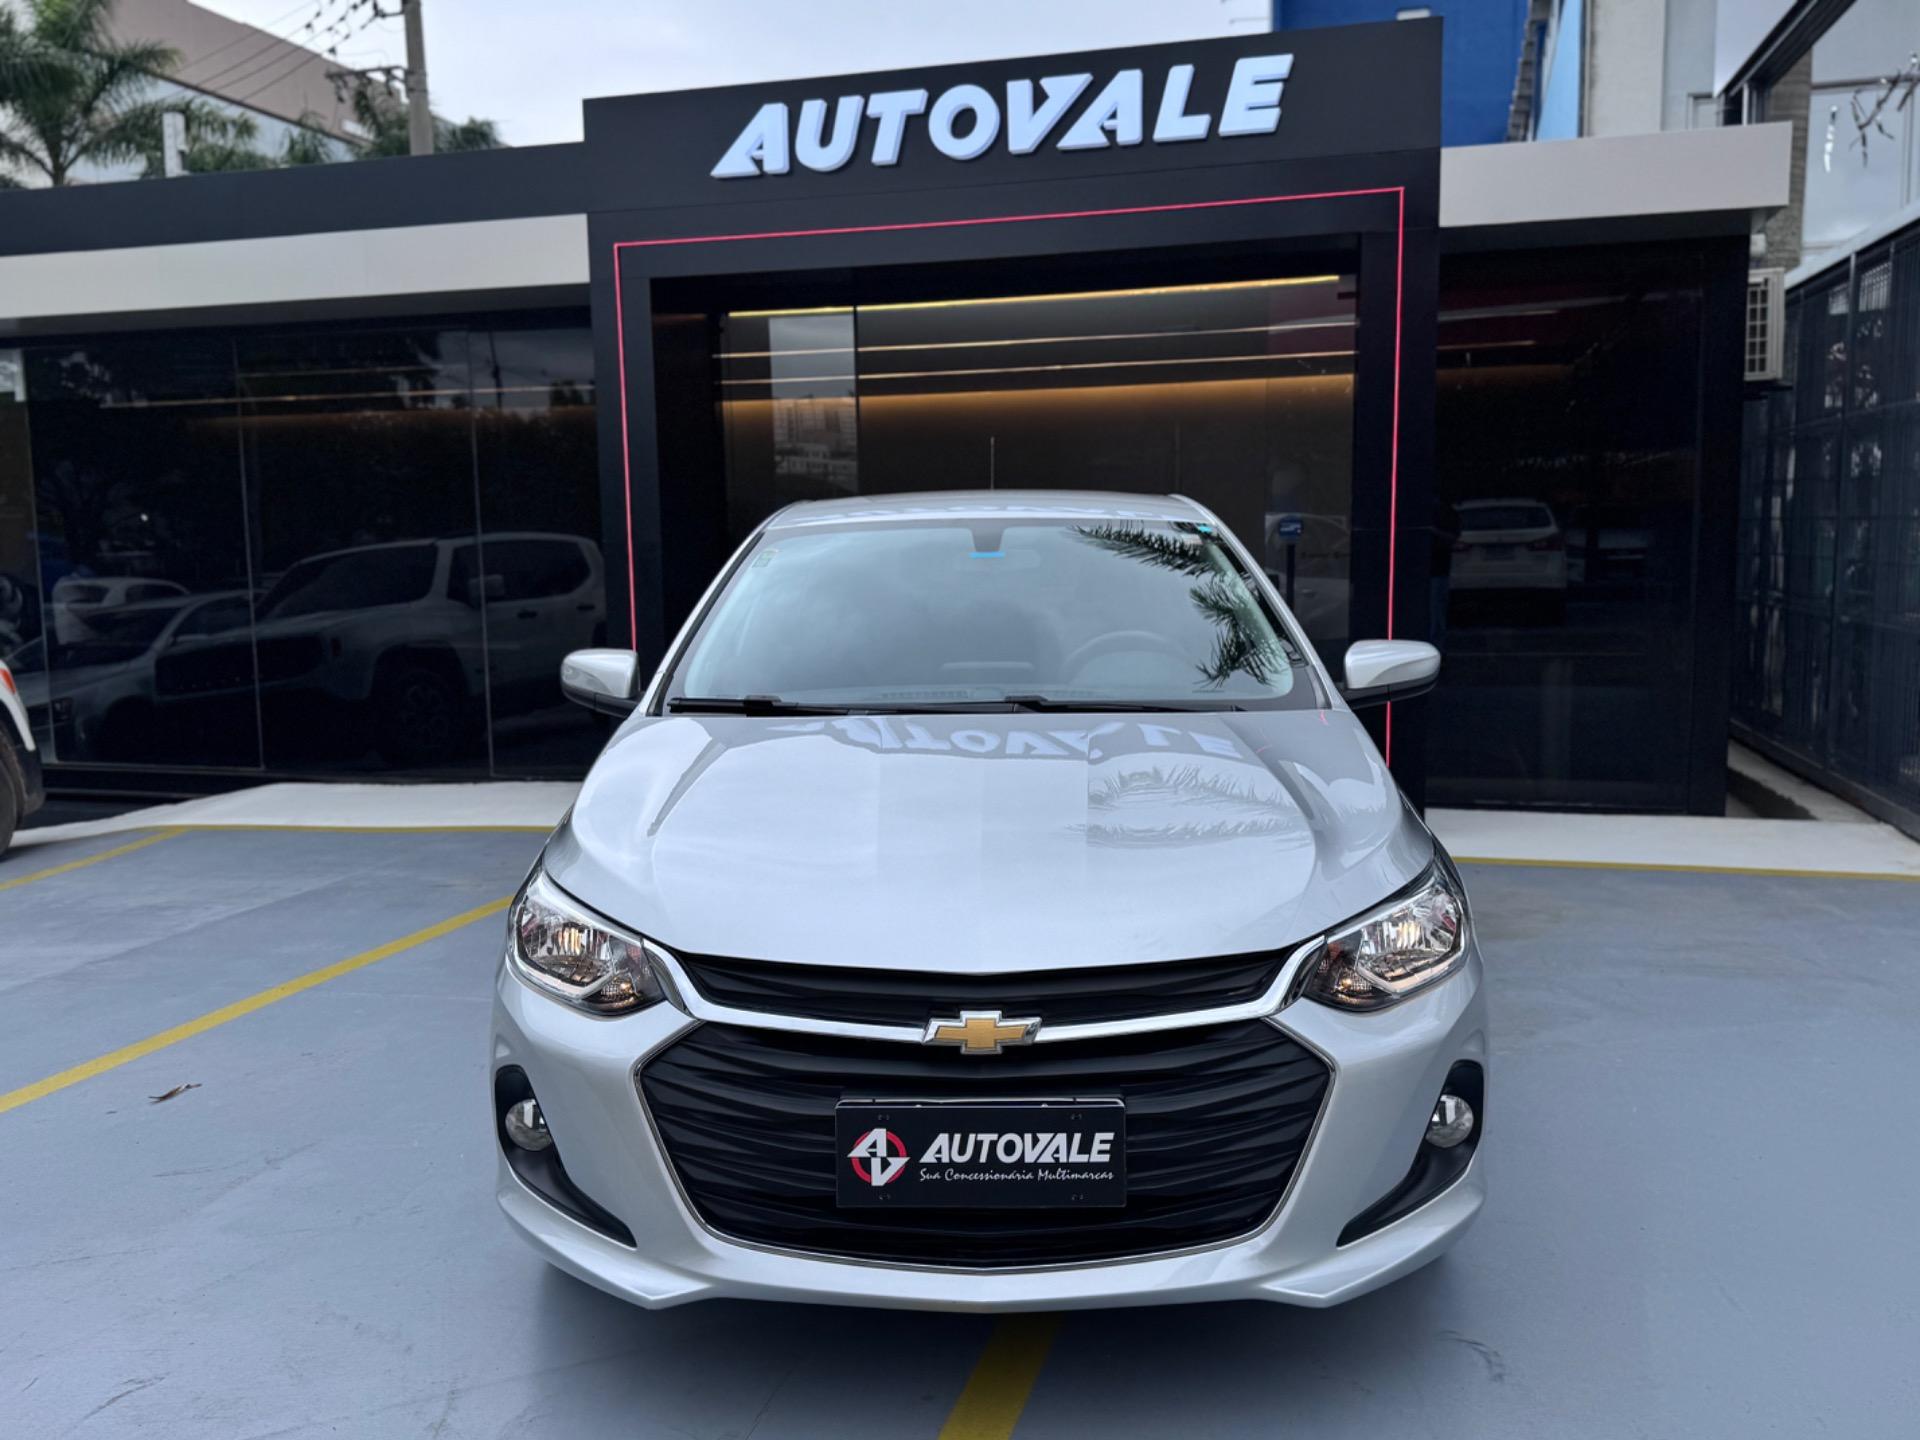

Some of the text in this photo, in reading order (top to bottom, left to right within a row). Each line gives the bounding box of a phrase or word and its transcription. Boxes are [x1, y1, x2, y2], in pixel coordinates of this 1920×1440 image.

[710, 53, 1293, 179] AUTOVALE
[919, 1132, 1115, 1164] AUTOVALE
[919, 1167, 1114, 1182] Sua Concessionária Multimarcas
